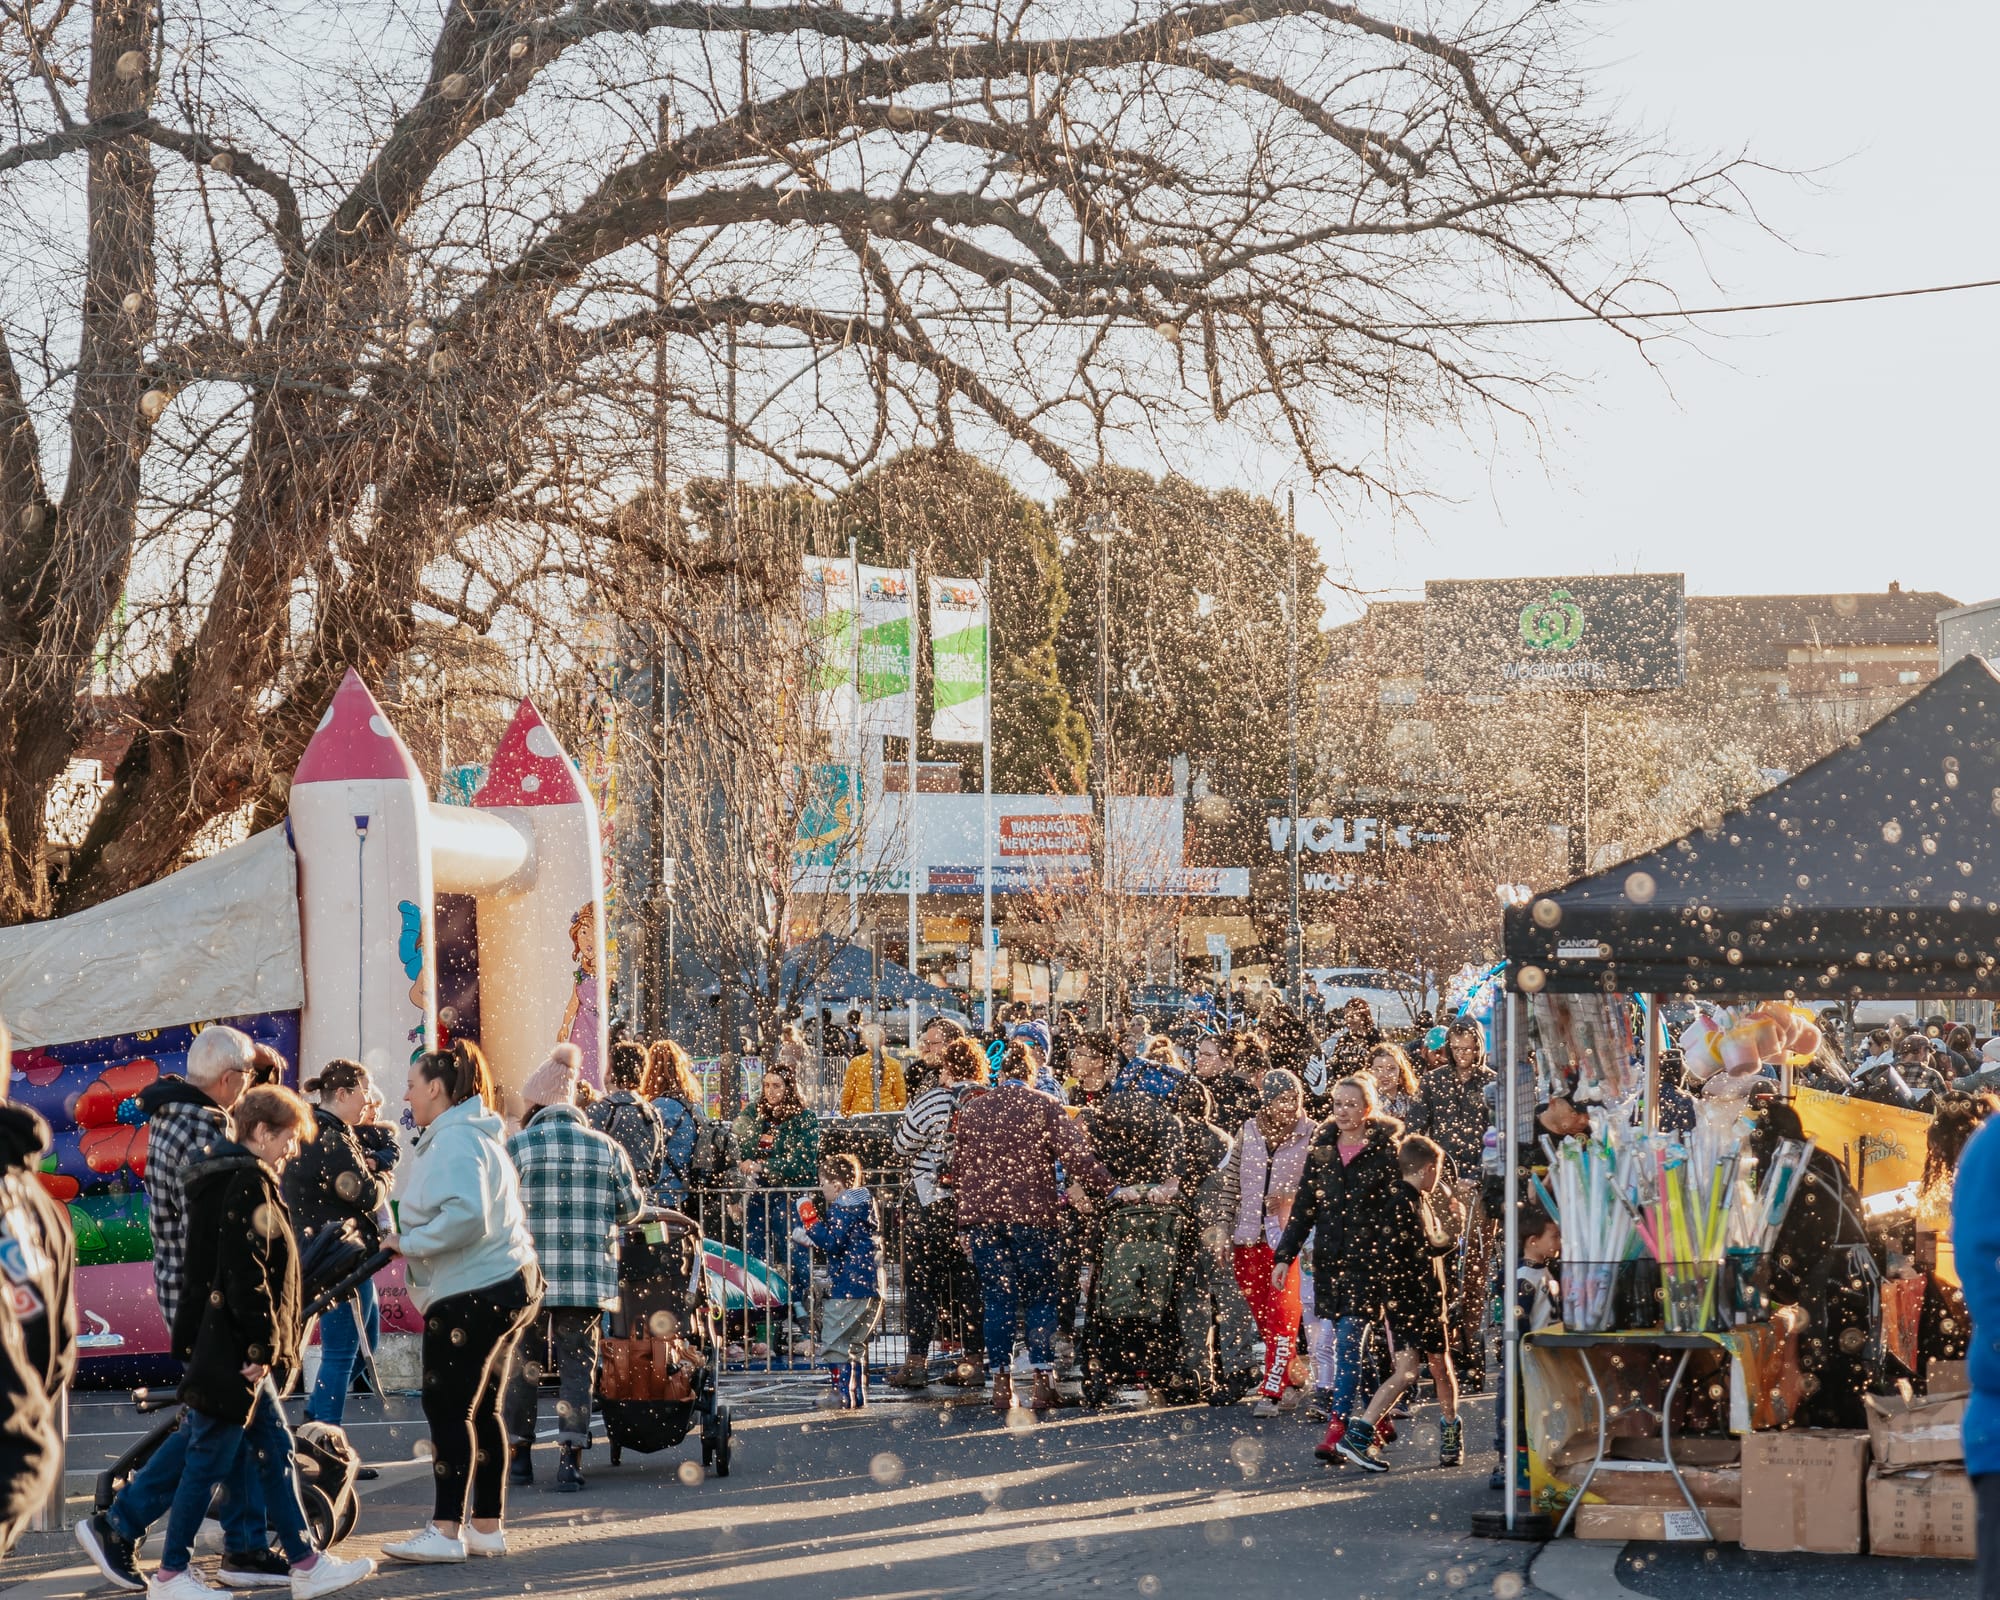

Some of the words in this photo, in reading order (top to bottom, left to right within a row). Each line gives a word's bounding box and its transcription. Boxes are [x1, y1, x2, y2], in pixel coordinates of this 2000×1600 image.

[1010, 820, 1079, 834] WARRAGUL
[1267, 817, 1377, 852] WOLF
[1417, 831, 1450, 842] Partner
[1002, 836, 1087, 850] NEWSAGENCY
[1304, 873, 1355, 891] WOLF
[1265, 1335, 1290, 1393] BOSTON
